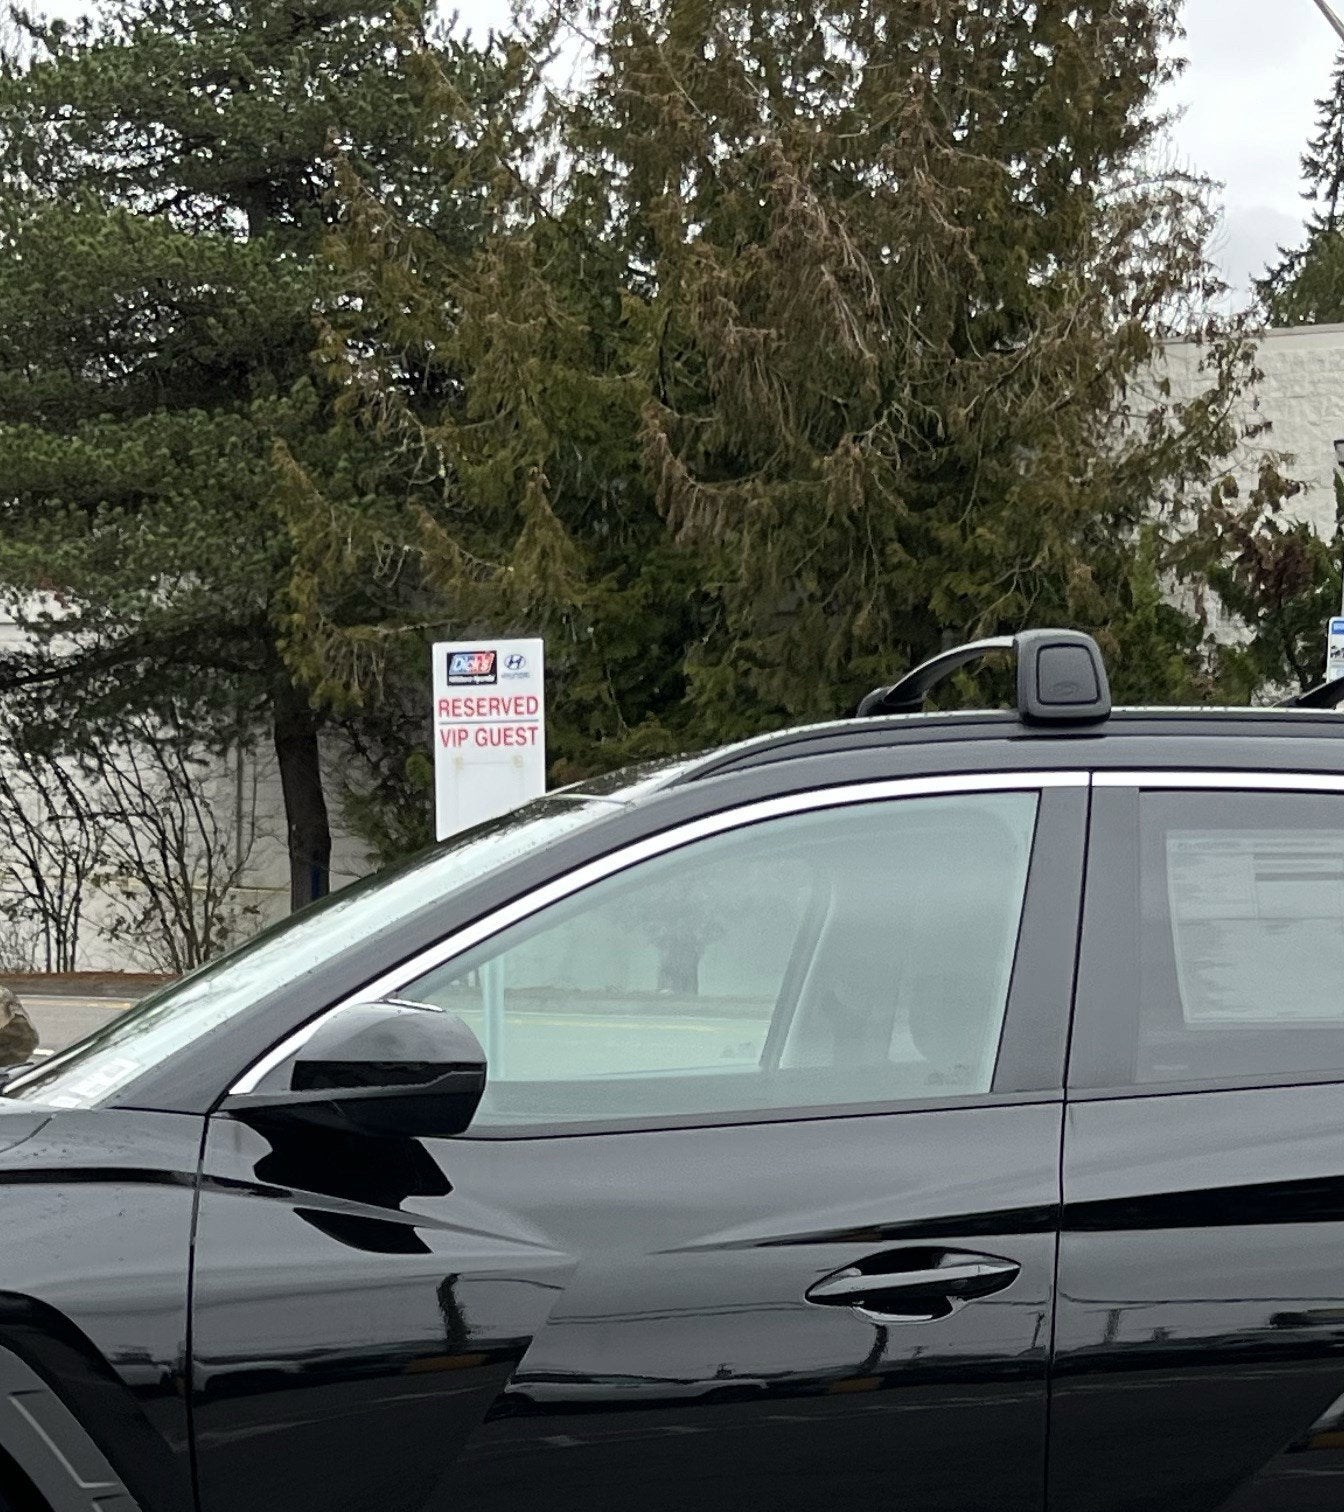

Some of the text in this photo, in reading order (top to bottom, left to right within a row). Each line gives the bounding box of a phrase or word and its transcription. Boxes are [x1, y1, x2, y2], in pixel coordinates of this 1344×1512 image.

[438, 696, 539, 718] RESERVED
[440, 726, 539, 748] VIP GUEST
